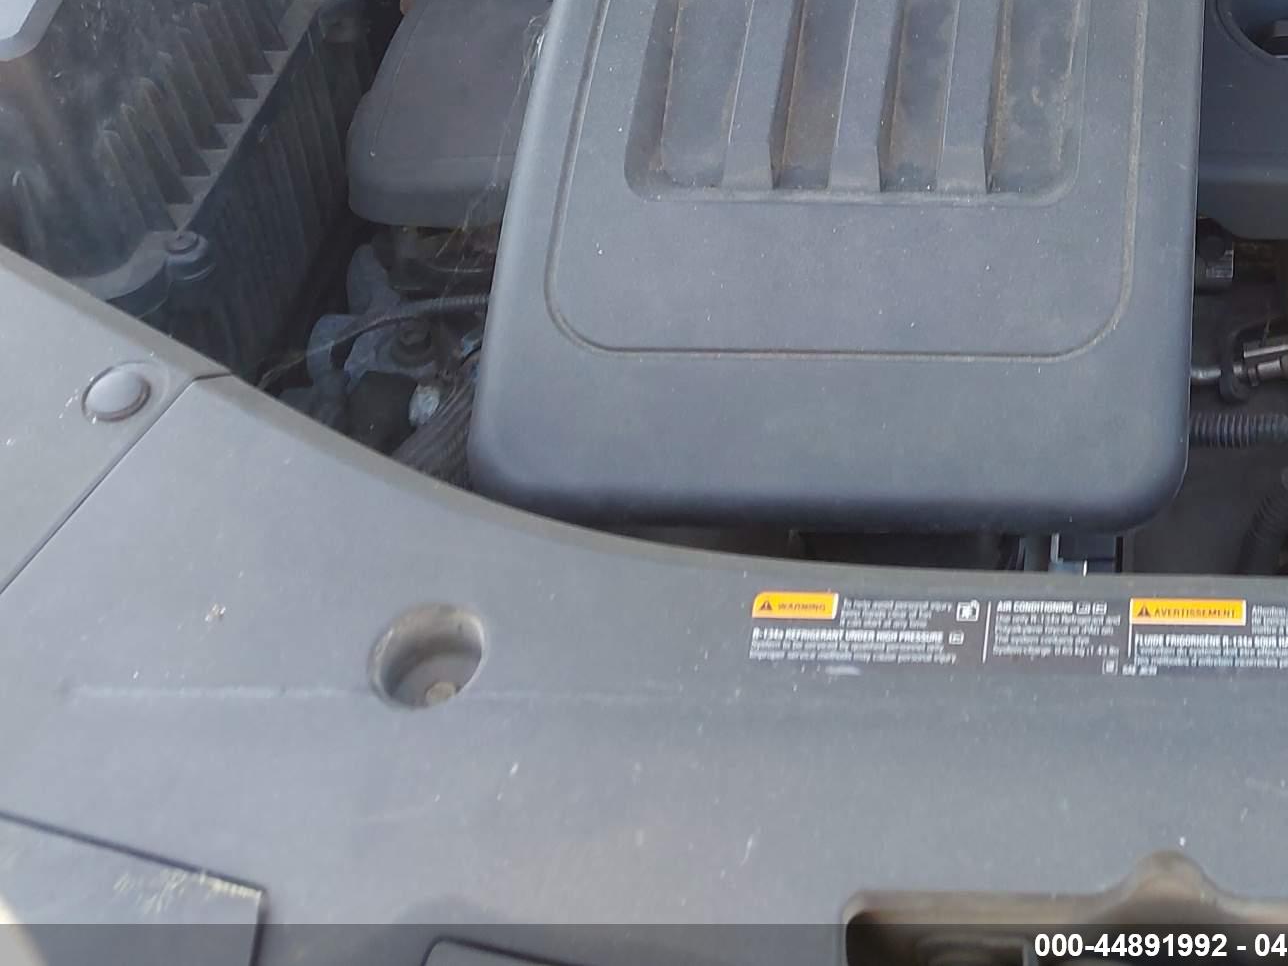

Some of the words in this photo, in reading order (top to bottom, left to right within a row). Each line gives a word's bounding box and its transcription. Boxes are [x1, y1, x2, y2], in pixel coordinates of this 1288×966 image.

[778, 602, 826, 612] WARNING
[996, 601, 1012, 613] AIR
[1013, 601, 1074, 614] CONDITIONING
[1154, 607, 1236, 619] AVERTISSEMENT
[785, 629, 844, 641] REFRIGERANT
[845, 630, 875, 642] UNDER
[876, 631, 898, 642] HIGH
[898, 631, 944, 643] PRESSURE
[1134, 634, 1164, 646] FLUIDE
